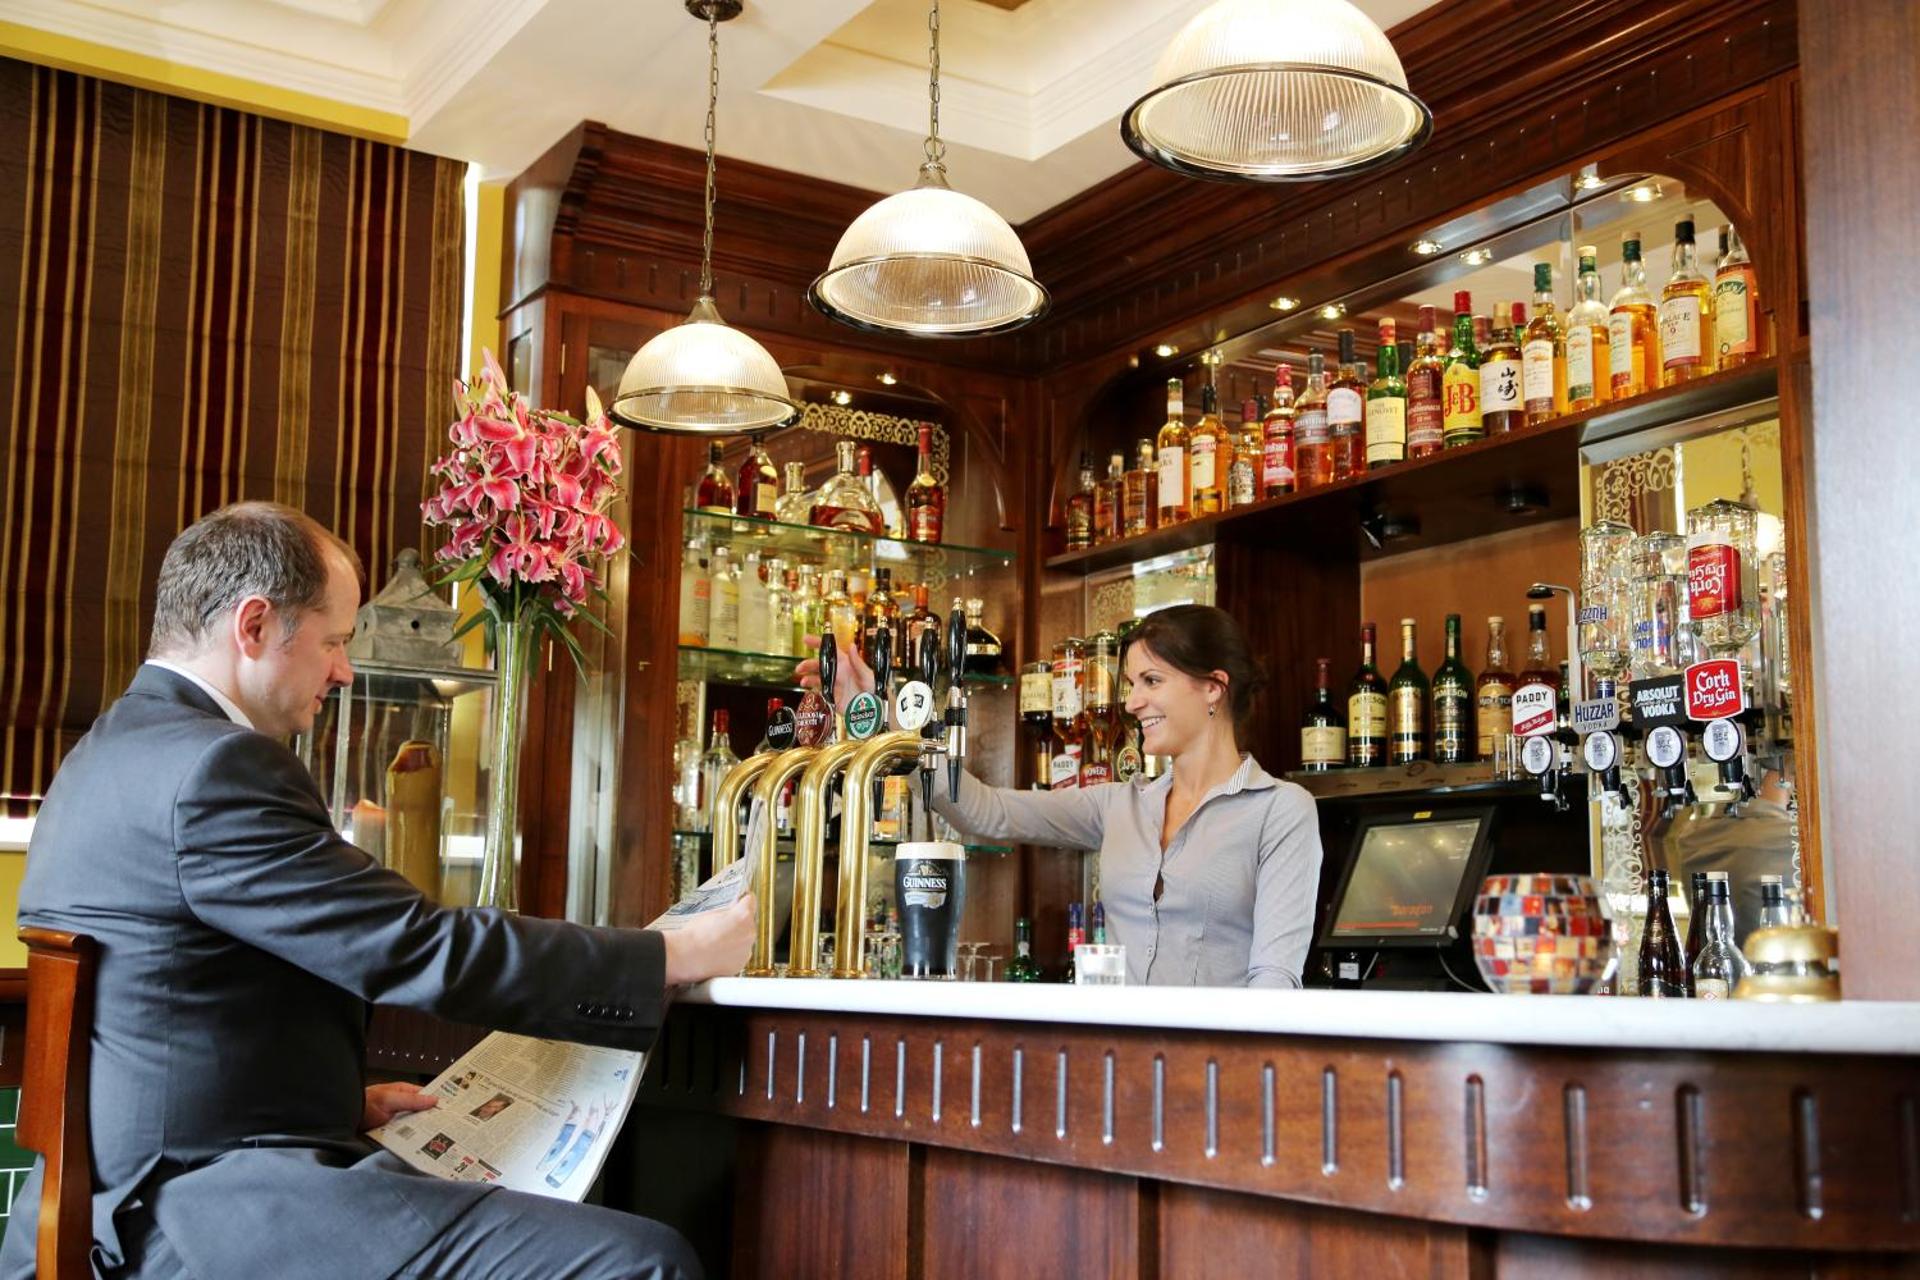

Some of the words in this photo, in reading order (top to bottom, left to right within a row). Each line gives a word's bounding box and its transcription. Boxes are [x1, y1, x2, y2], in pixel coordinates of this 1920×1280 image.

[1690, 576, 1721, 596] Cork
[1580, 606, 1608, 621] HUZZ
[1695, 669, 1730, 691] Cork
[1516, 691, 1548, 704] PADDY
[1636, 685, 1680, 702] ABSOLUT
[1692, 691, 1714, 708] Dry
[1714, 689, 1736, 707] Gin
[1575, 703, 1614, 722] HUZZAR
[1642, 702, 1676, 718] VODKA
[903, 876, 947, 890] GUINNESS
